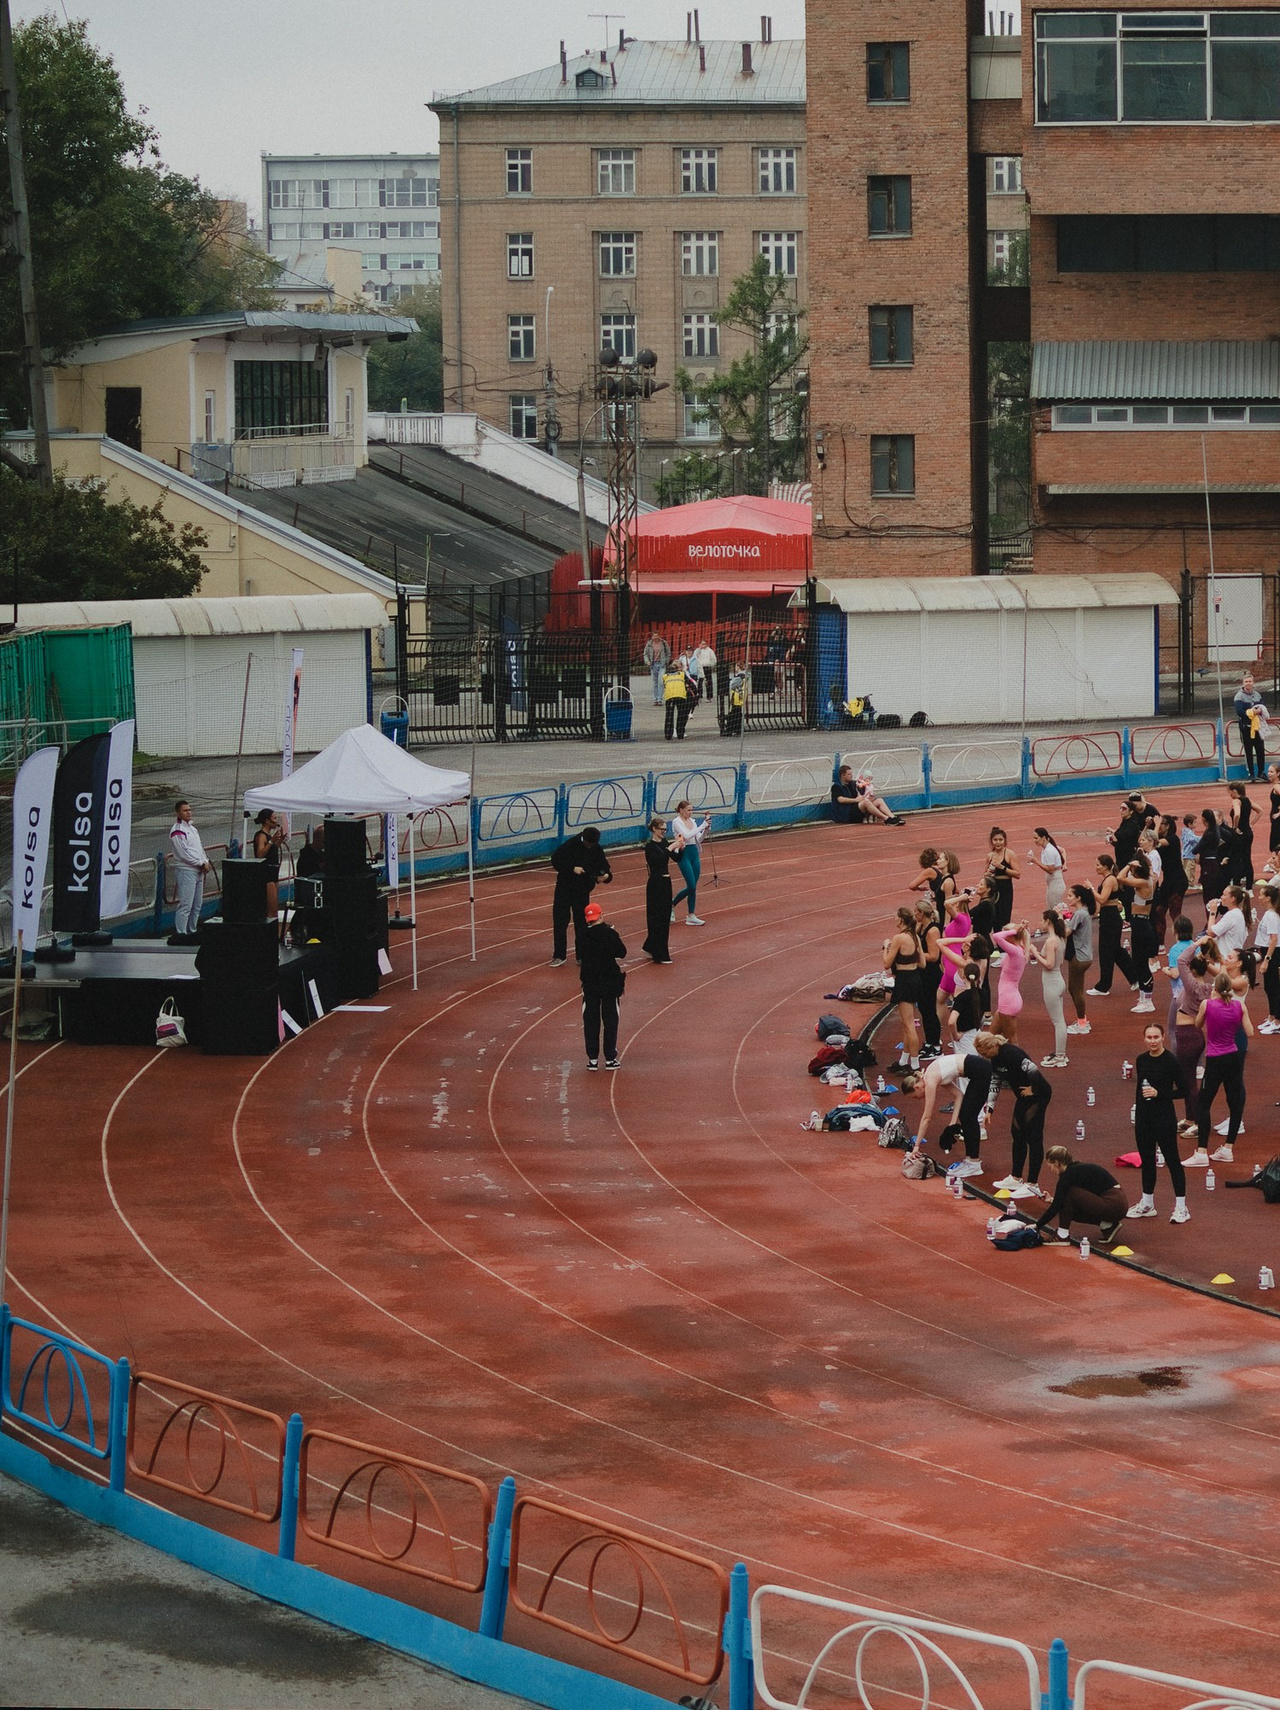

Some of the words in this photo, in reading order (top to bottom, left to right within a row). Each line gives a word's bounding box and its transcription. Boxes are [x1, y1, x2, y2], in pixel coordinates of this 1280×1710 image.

[688, 544, 761, 558] велоточка
[21, 806, 41, 909] kolsa
[67, 792, 93, 892] kolsa
[104, 778, 123, 876] kolsa
